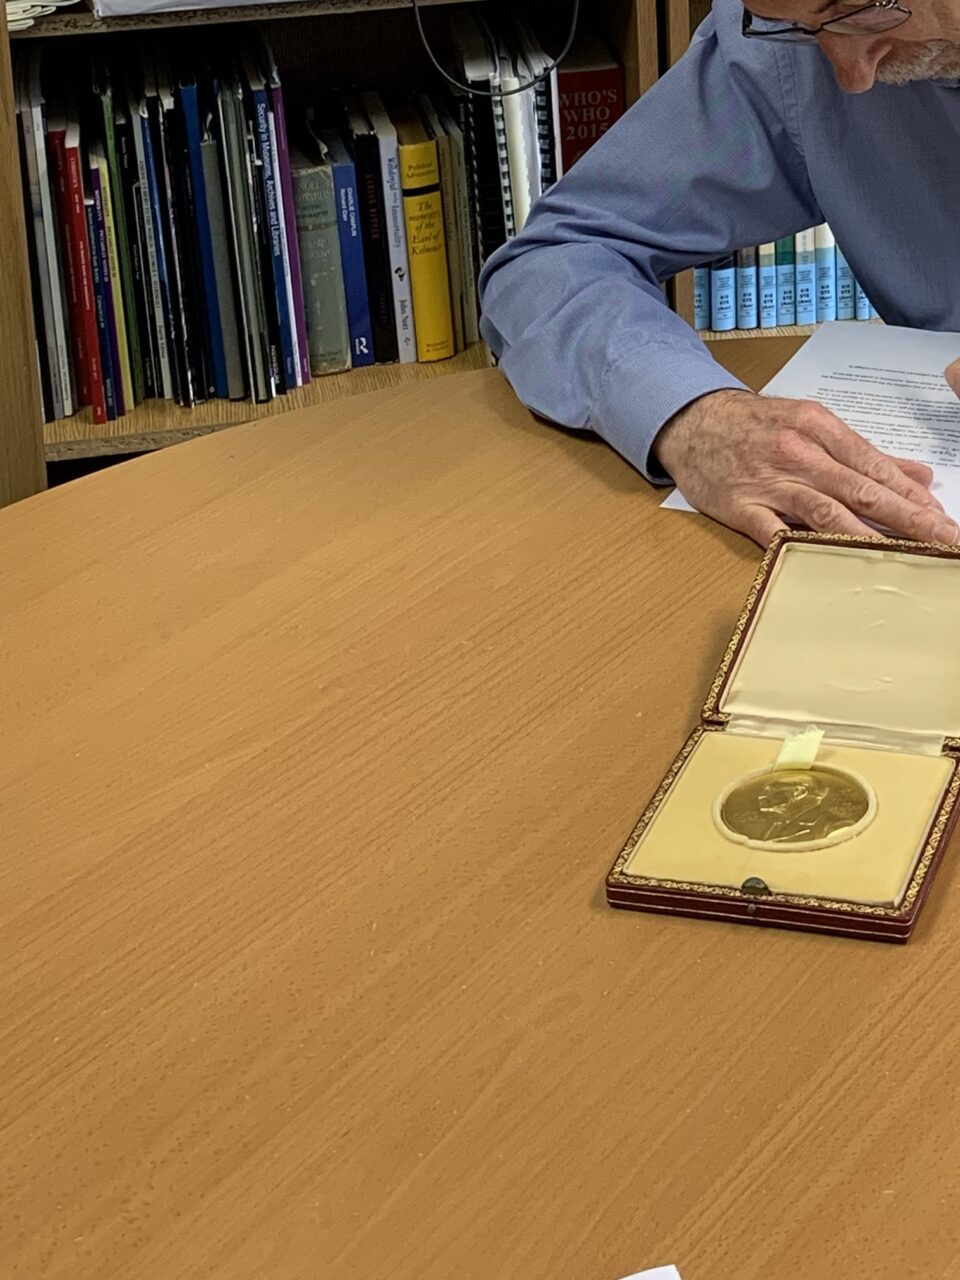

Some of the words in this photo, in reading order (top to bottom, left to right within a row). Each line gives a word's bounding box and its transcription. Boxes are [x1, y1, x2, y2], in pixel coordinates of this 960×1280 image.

[560, 89, 617, 106] WHO'S
[257, 103, 266, 134] Security
[564, 106, 610, 123] WHO
[260, 134, 267, 142] in
[262, 142, 272, 179] Museums,
[266, 180, 276, 209] Archives
[347, 187, 355, 212] CHARLIE
[417, 201, 432, 211] The
[269, 210, 277, 225] and
[350, 212, 358, 237] CHAPLIN
[425, 221, 435, 229] the
[272, 225, 281, 257] Libraries
[412, 234, 432, 244] Earl
[399, 299, 408, 314] John
